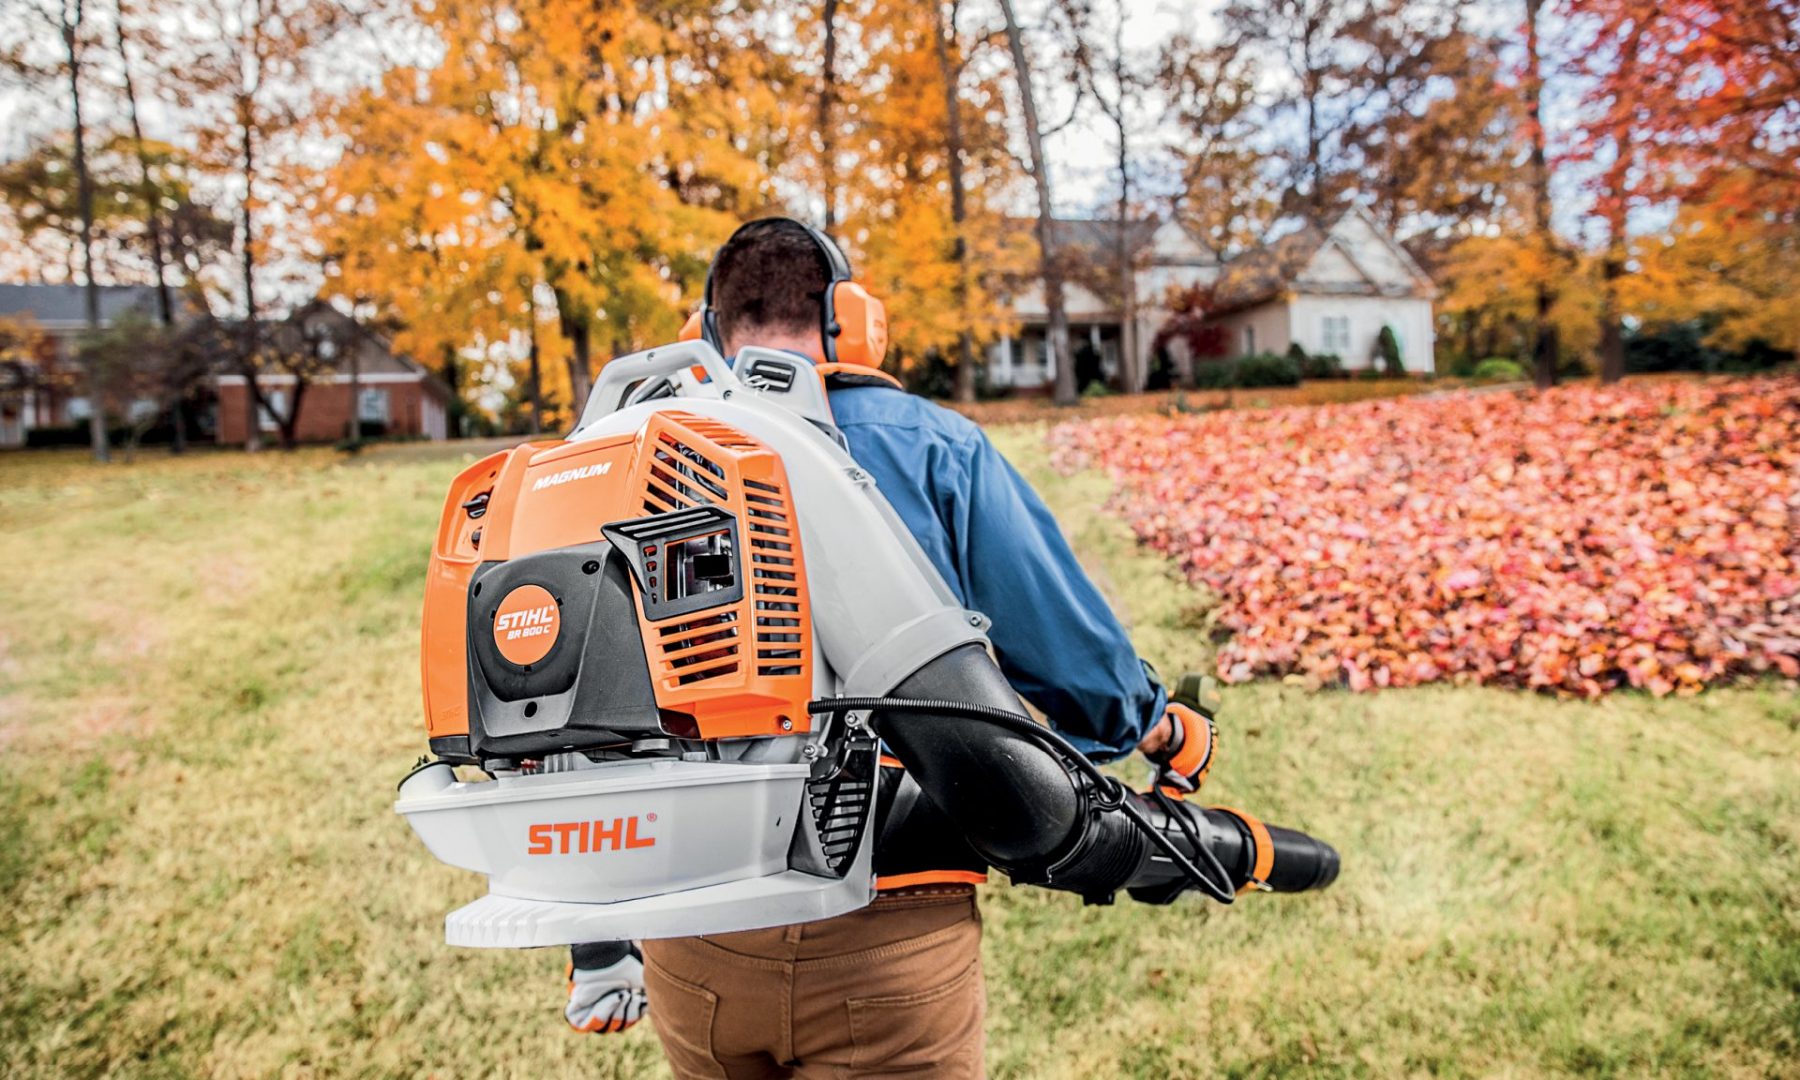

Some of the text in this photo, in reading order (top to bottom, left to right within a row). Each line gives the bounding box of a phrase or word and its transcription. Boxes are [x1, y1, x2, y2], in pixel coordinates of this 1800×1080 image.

[532, 462, 613, 491] MAGNUM
[507, 624, 552, 640] BR 800 C
